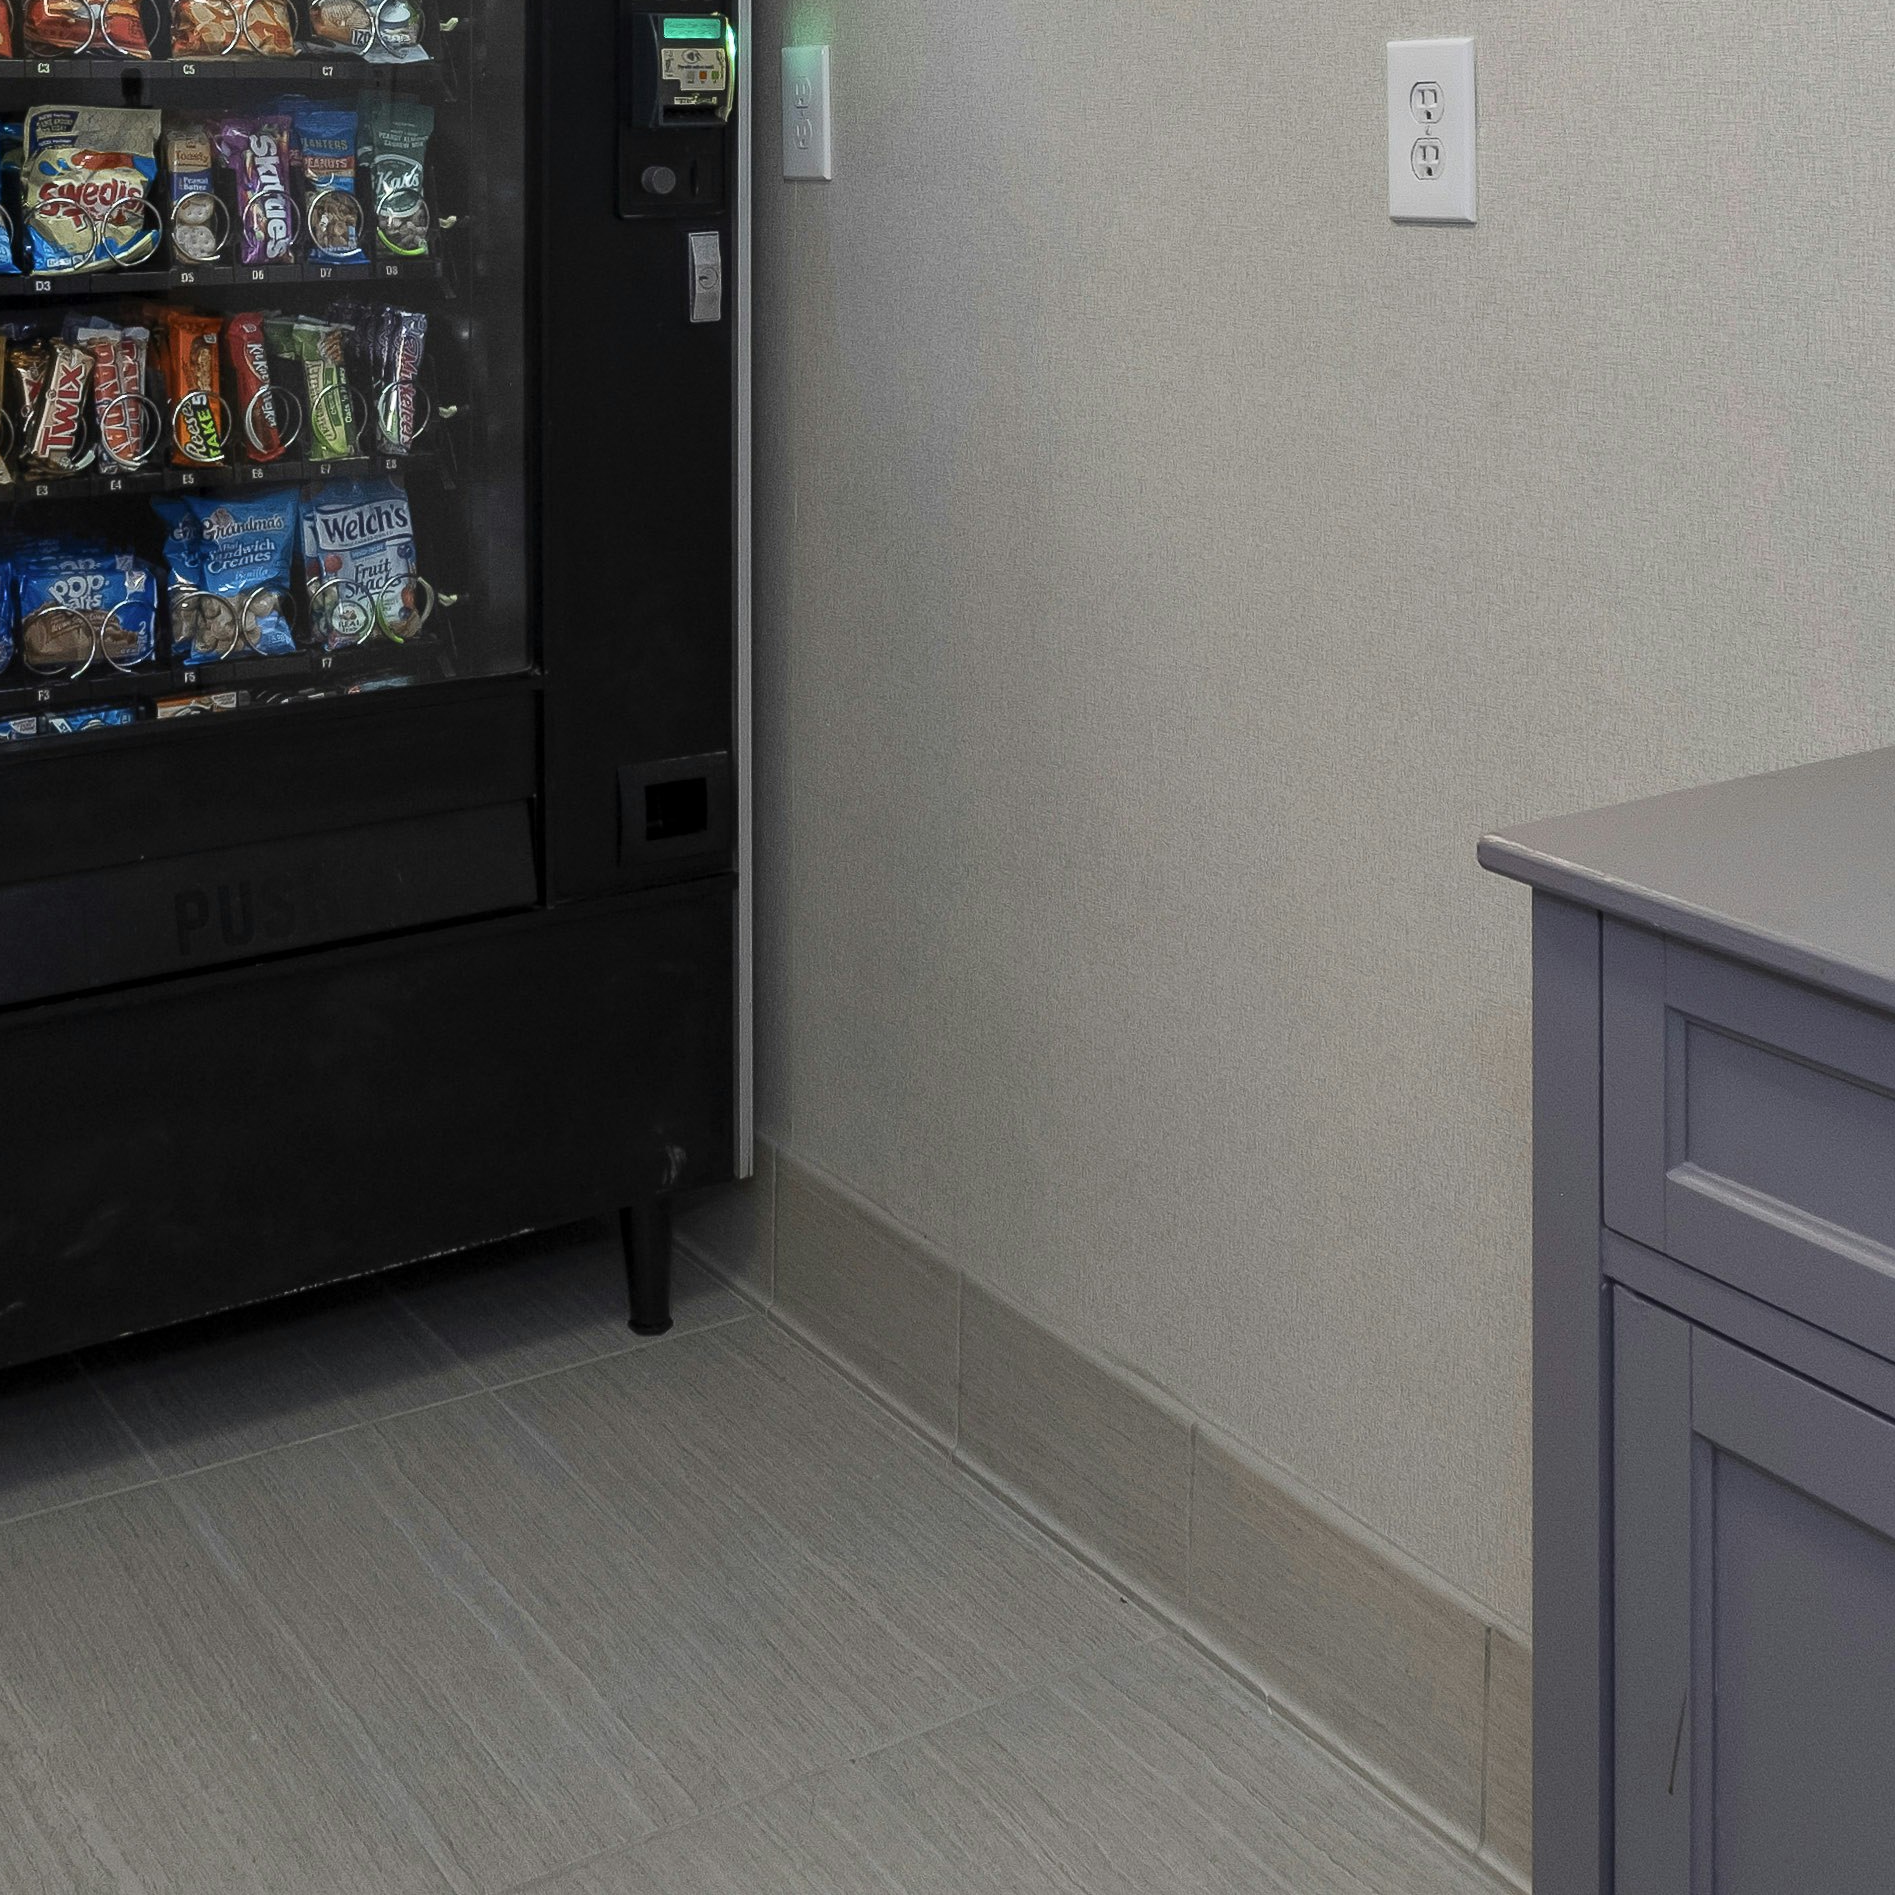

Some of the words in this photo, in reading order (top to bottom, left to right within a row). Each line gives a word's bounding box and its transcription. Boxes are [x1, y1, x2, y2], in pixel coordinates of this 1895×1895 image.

[249, 134, 288, 259] Skittles
[252, 270, 265, 281] D6
[320, 268, 333, 278] D7
[35, 281, 51, 292] D3
[37, 363, 85, 458] TWIX
[199, 408, 222, 457] TAKE
[36, 485, 49, 497] E3
[110, 479, 123, 491] E4
[182, 474, 195, 485] E5
[201, 514, 285, 543] Grandma's
[321, 504, 409, 544] Welch's
[207, 539, 276, 563] Sandwich
[207, 551, 273, 574] Cremes
[353, 557, 393, 580] Fruit
[38, 690, 51, 701] F3
